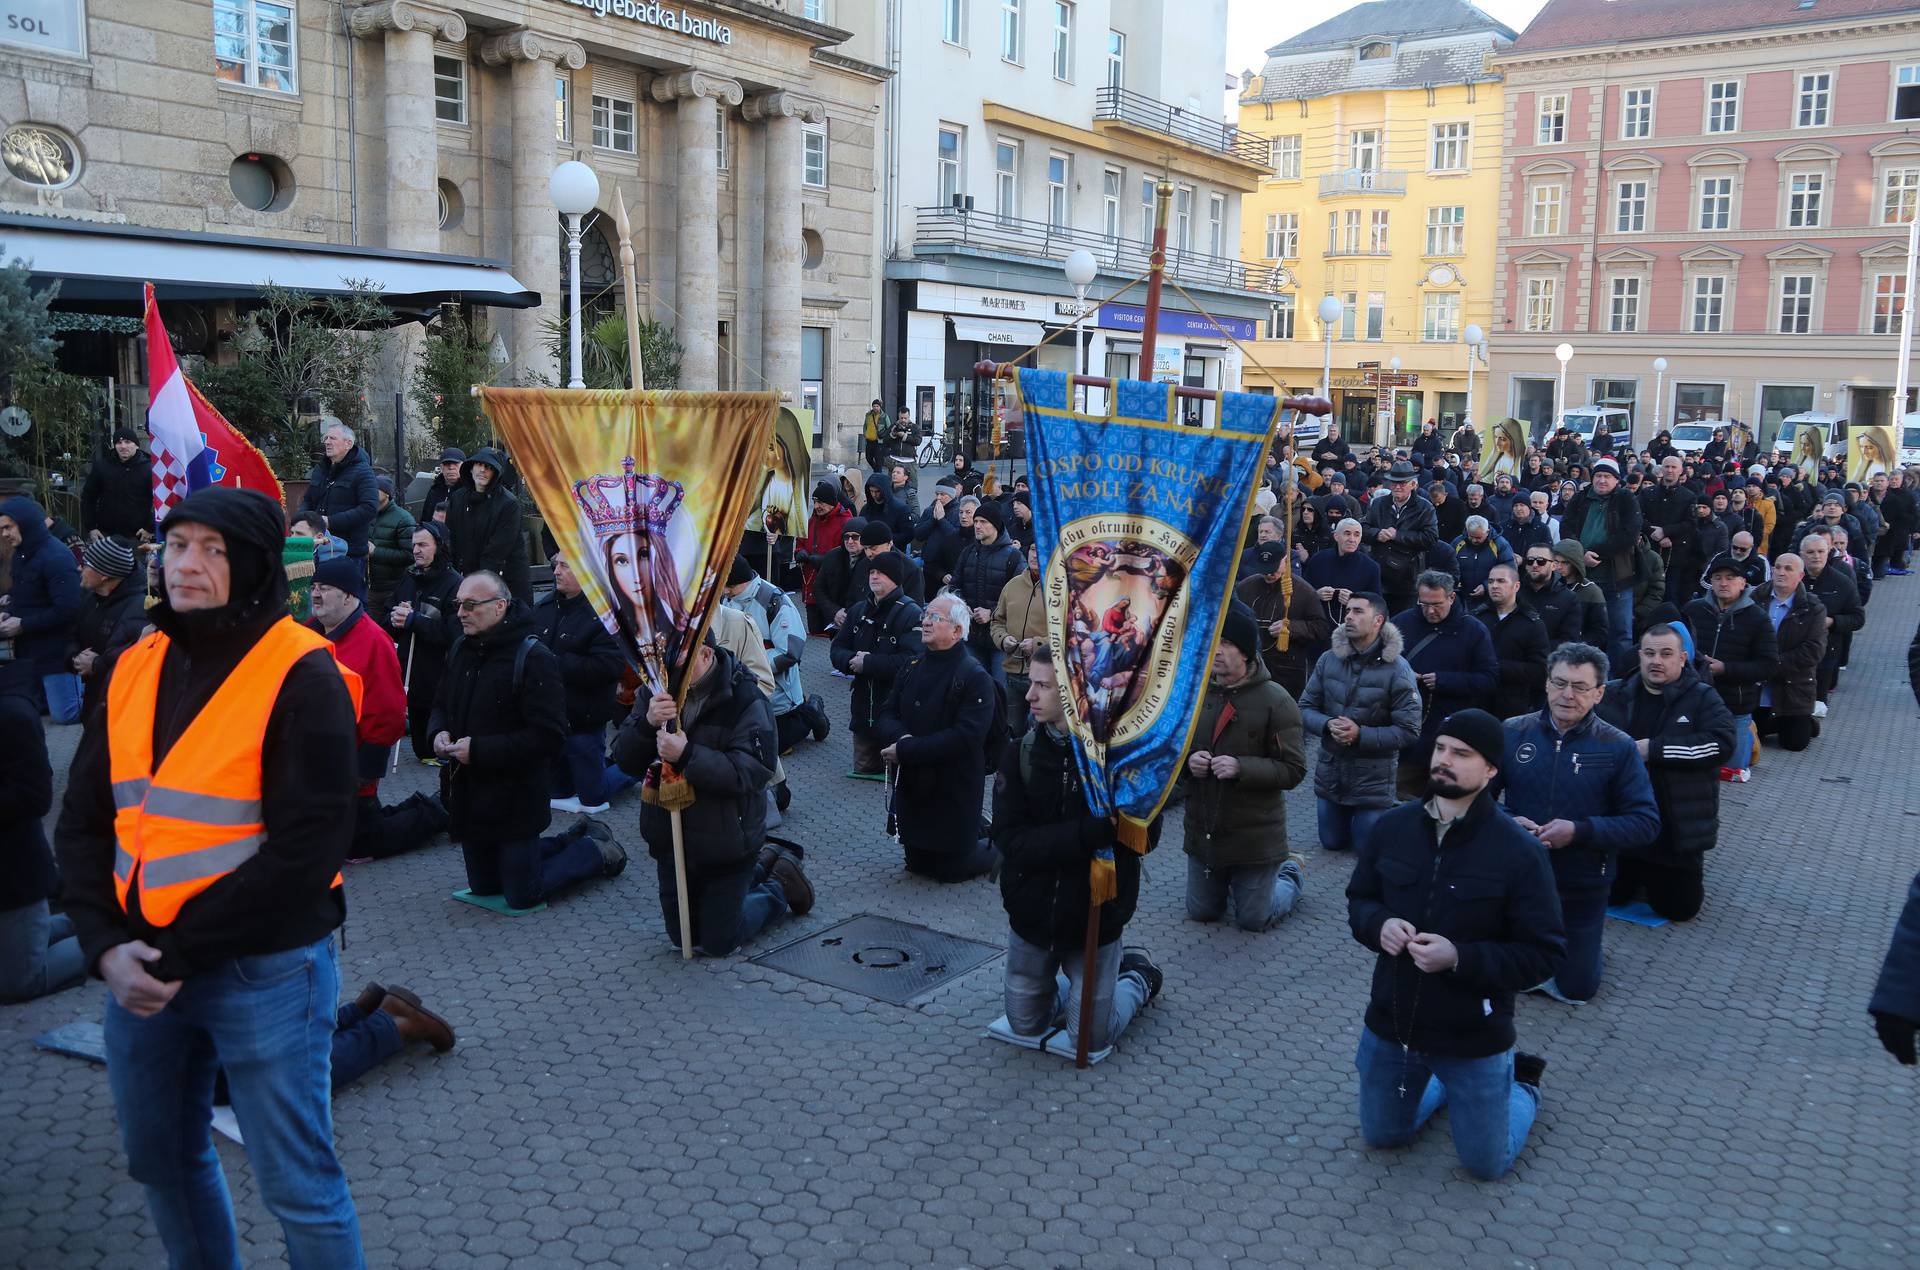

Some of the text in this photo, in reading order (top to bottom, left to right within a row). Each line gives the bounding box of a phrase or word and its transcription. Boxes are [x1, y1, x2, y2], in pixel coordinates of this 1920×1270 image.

[8, 14, 50, 36] SOL
[682, 10, 731, 45] banka
[1113, 312, 1133, 322] VISITOR
[1187, 321, 1203, 329] CENTAR
[988, 332, 1014, 343] CHANEL
[1108, 453, 1142, 472] OD
[1060, 480, 1119, 501] MOLI
[1128, 482, 1158, 502] ZA
[1091, 520, 1143, 536] okrunio
[1158, 659, 1172, 678] bio
